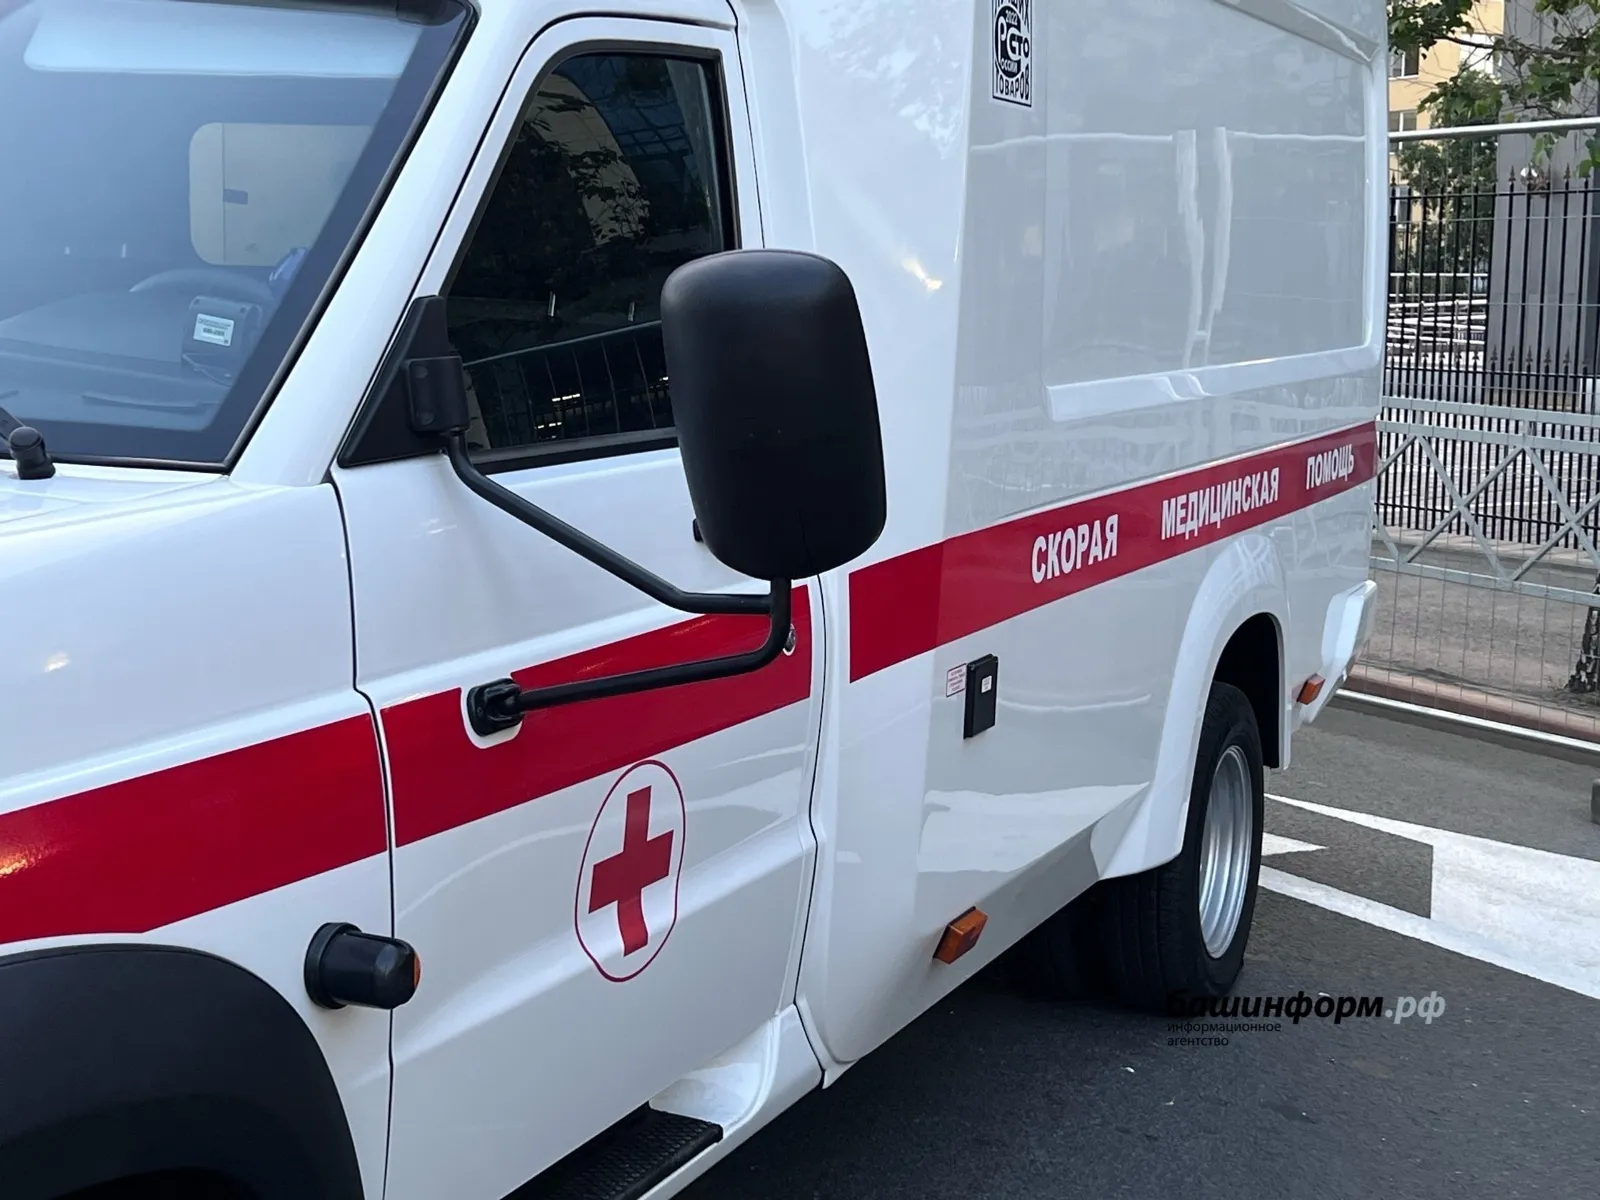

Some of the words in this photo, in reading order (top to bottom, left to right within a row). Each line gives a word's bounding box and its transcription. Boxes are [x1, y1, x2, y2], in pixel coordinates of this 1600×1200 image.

[1031, 514, 1119, 584] СКОРАЯ
[1161, 467, 1279, 540] МЕДИЦИНСКАЯ
[1306, 444, 1355, 490] ПОМОЩЬ
